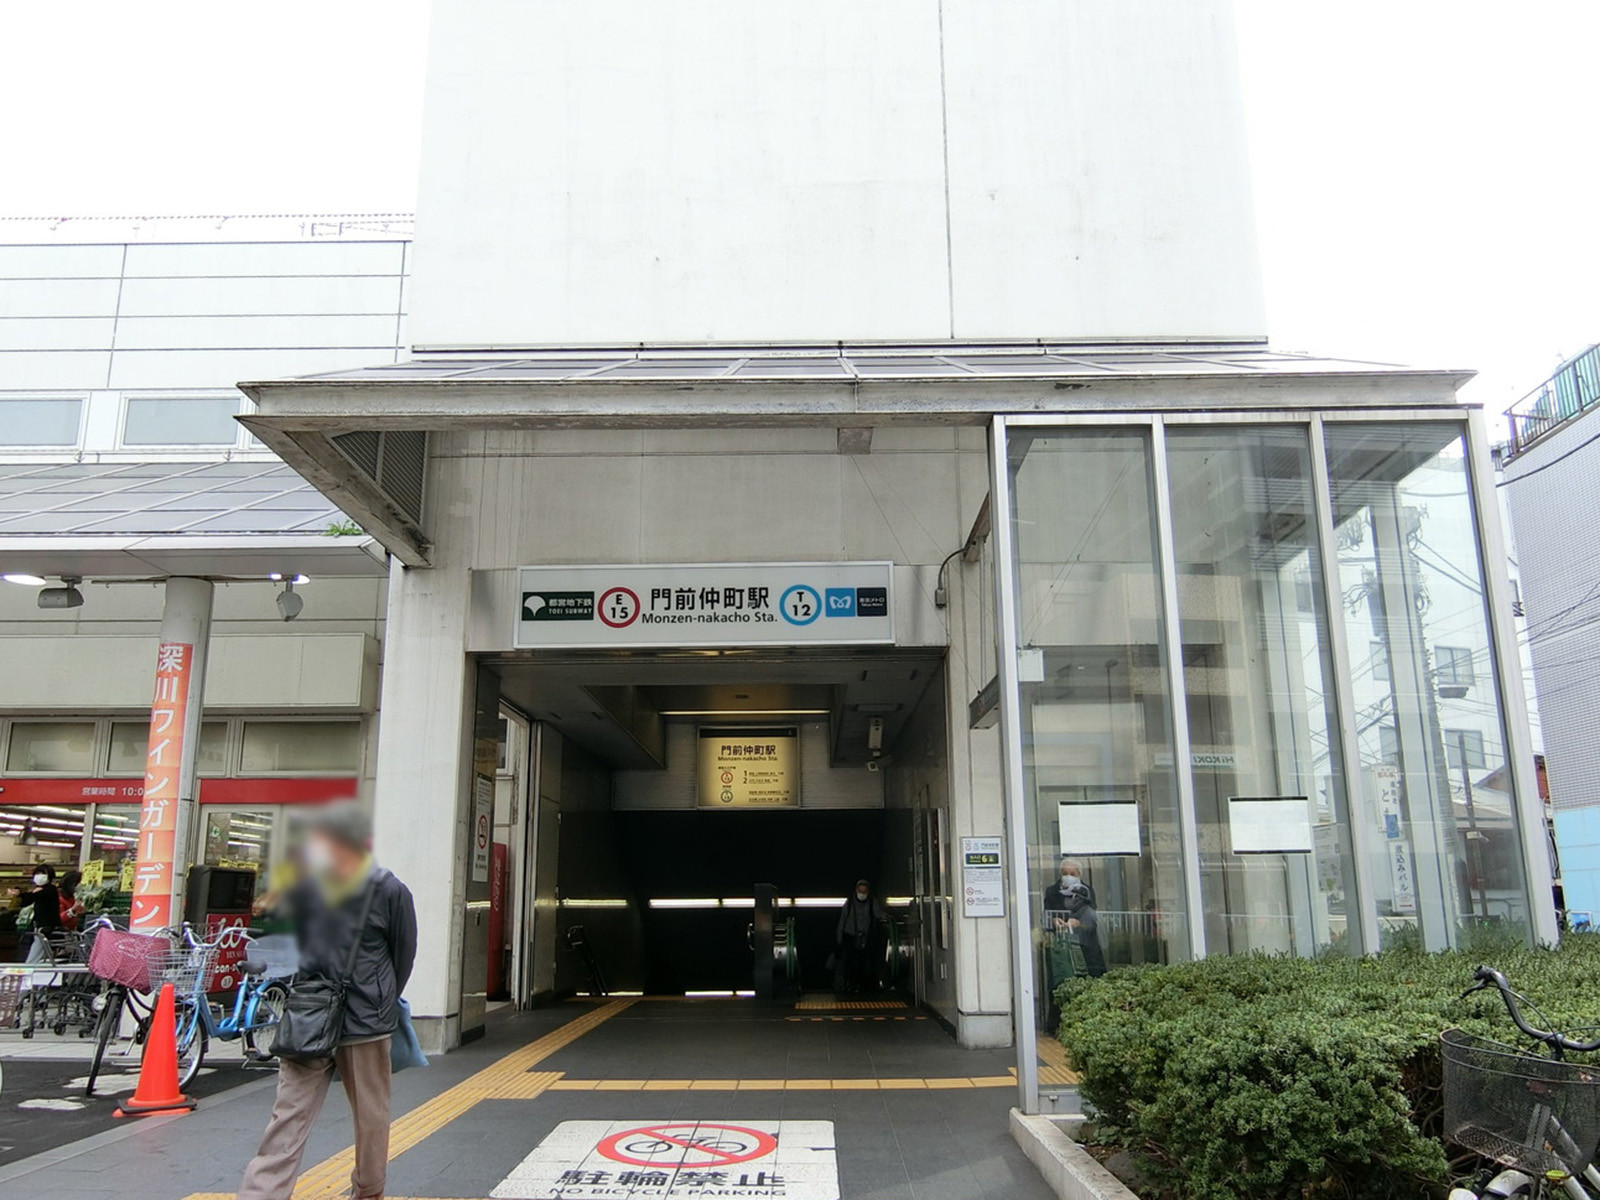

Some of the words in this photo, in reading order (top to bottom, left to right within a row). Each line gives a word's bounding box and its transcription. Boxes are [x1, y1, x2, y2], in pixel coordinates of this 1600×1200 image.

[548, 597, 593, 607] 都営地下鉄
[616, 594, 623, 605] E
[650, 586, 770, 611] 門前仲町駅
[796, 592, 805, 602] T
[610, 606, 629, 619] 15
[792, 604, 811, 616] 12
[642, 610, 751, 624] Monzen-nakacho
[754, 611, 778, 623] Sta.
[721, 745, 776, 756] 門前仲町駅
[133, 644, 185, 925] 深川ワインガーデン
[82, 786, 116, 795] 営業時間
[981, 854, 987, 863] 6
[555, 1169, 788, 1187] 駐輪禁止
[590, 1188, 680, 1196] BICYCLE
[689, 1188, 787, 1196] PARKING
